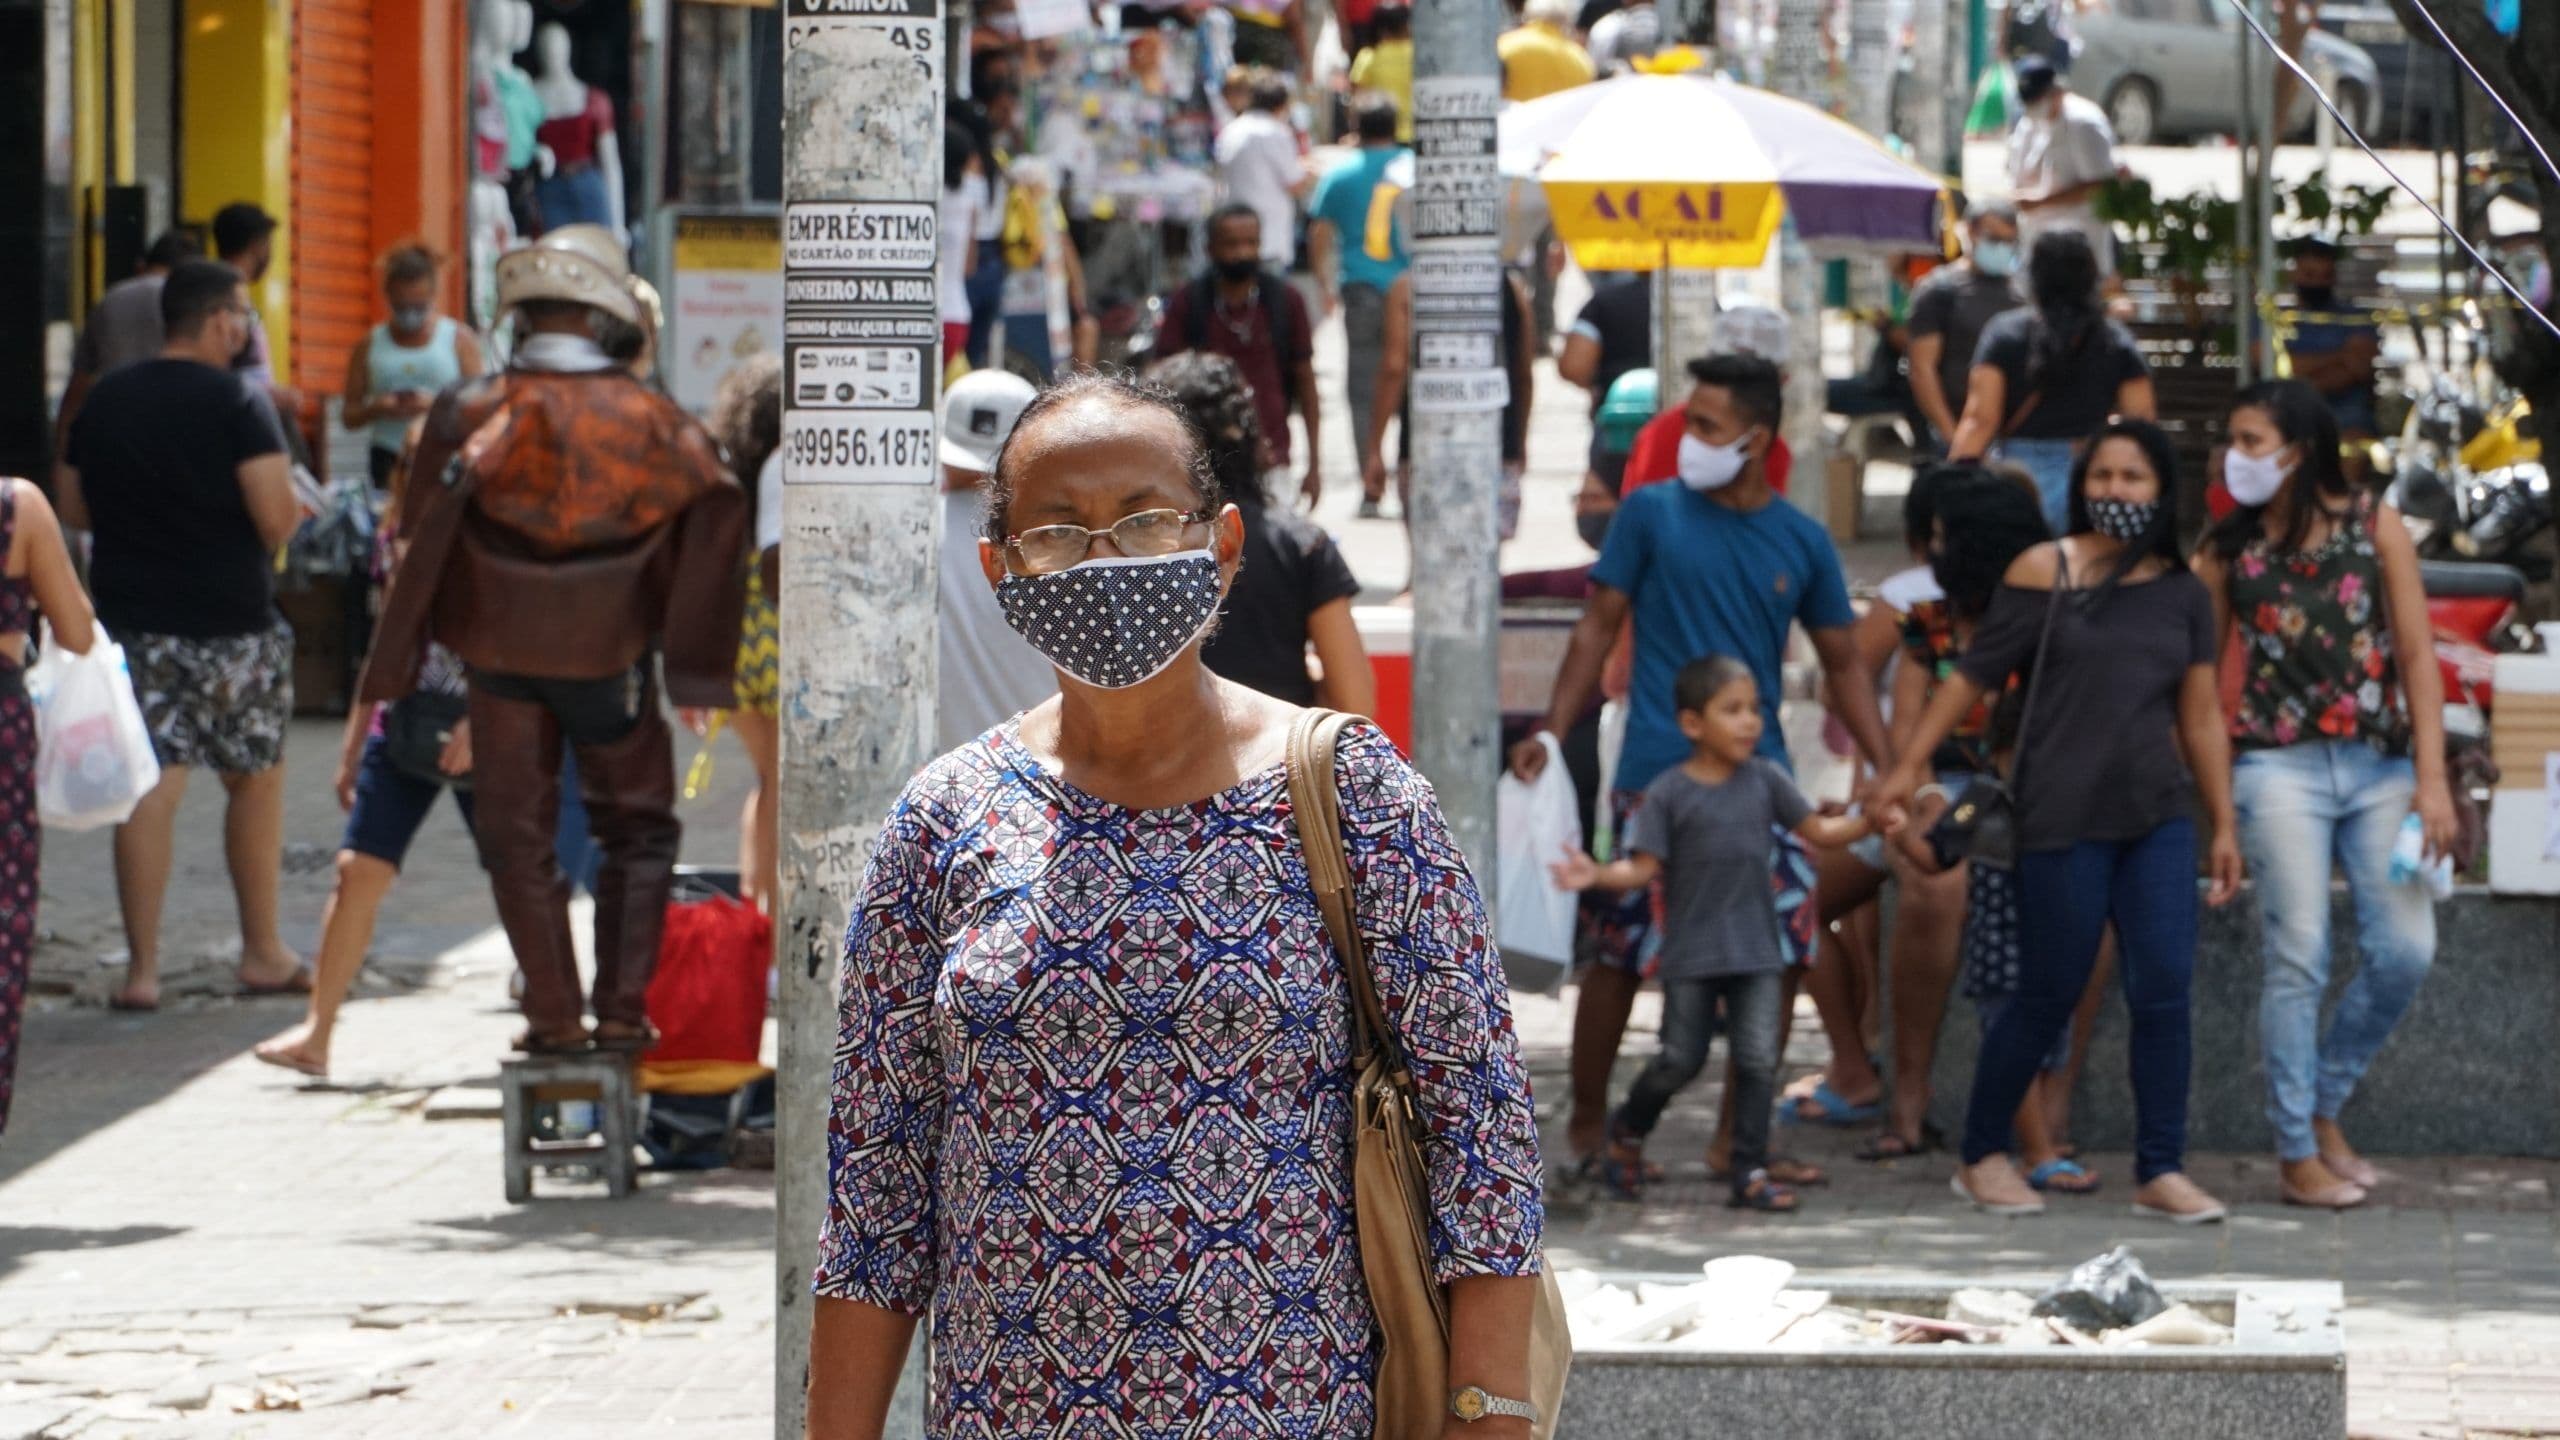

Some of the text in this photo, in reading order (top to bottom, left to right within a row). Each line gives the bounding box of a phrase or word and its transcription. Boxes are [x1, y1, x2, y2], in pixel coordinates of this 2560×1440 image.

[789, 207, 934, 241] EMPRÉSTIMO
[801, 246, 853, 261] CARTÃO
[857, 249, 873, 260] DE
[787, 279, 934, 301] DINHEIRO NA HORA
[829, 320, 894, 337] QUALQUER
[825, 355, 858, 367] VISA
[794, 427, 932, 467] 99956.1875
